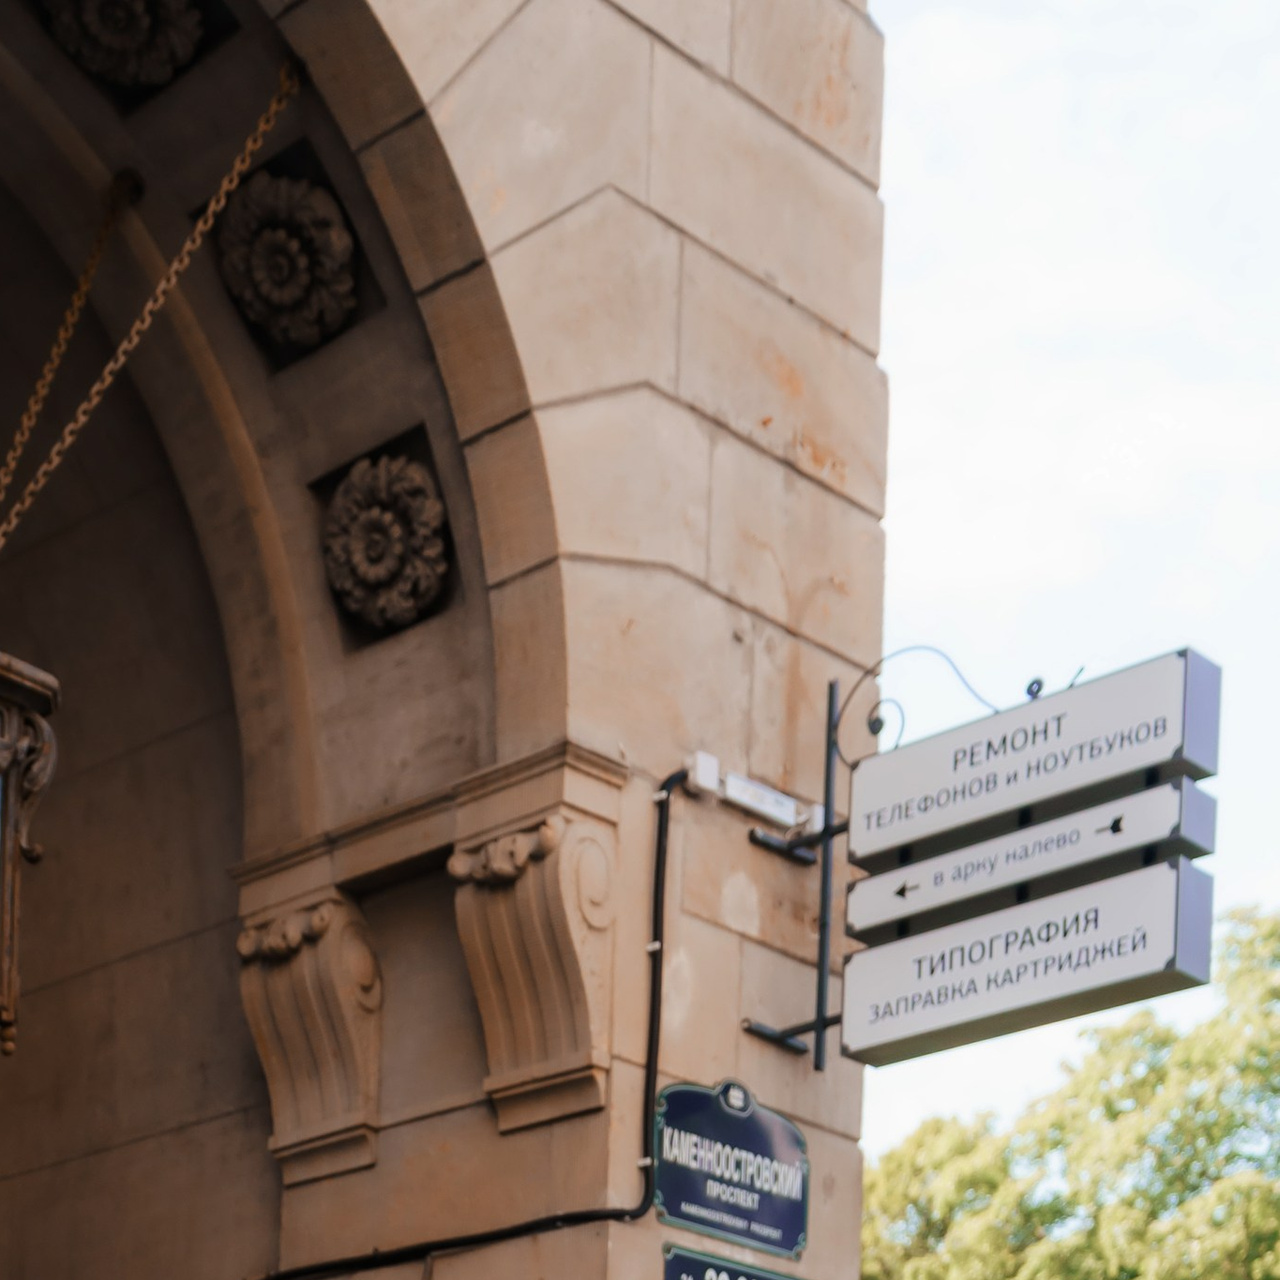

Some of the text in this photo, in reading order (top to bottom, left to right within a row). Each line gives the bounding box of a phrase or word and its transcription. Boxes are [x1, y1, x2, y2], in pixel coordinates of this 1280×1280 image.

[863, 716, 1168, 832] ТЕЛЕФОНОВ и НОУТБУКОВ
[952, 713, 1068, 773] РЕМОНТ
[933, 829, 1081, 887] в арку налево
[868, 926, 1148, 1025] ЗАПРАВКА КАРТРИДЖЕЙ
[913, 907, 1100, 980] ТИПОГРАФИЯ
[662, 1126, 803, 1201] КАМЕННООСТРОВСКИЙ
[706, 1179, 760, 1210] ПРОСПЕКТ
